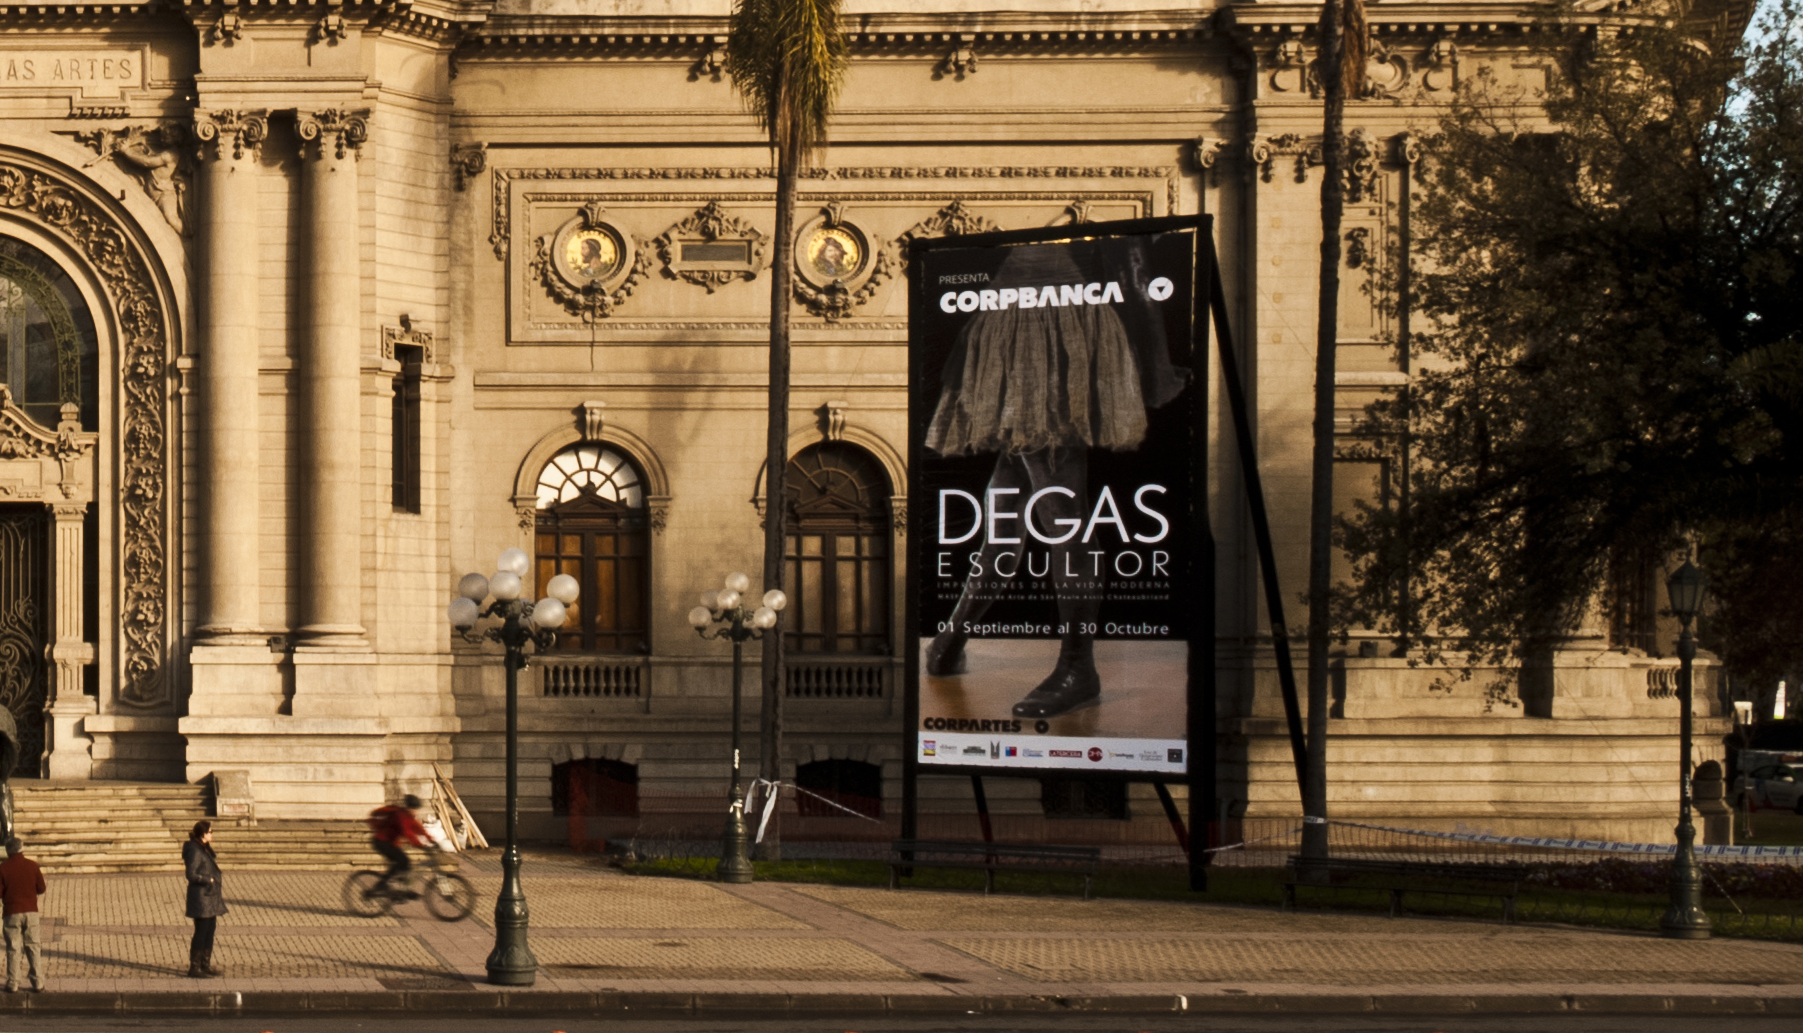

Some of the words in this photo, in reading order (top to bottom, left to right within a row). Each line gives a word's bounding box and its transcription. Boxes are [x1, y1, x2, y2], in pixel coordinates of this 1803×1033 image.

[52, 58, 133, 81] ARTES
[938, 272, 990, 285] PRESENTA
[939, 281, 1124, 314] CORPBANCA
[938, 484, 1169, 544] DEGAS
[938, 550, 1169, 577] ESCULTOR
[937, 581, 1024, 589] IMPRESIONES
[1032, 581, 1046, 589] DE
[1056, 581, 1068, 589] LA
[1076, 581, 1103, 589] VIDA
[1110, 581, 1170, 589] MODERNA
[937, 621, 954, 633] 01
[963, 621, 1051, 635] Septiembre
[1057, 621, 1070, 634] al
[1079, 622, 1096, 634] 30
[1105, 622, 1170, 634] Octubre
[923, 717, 1021, 733] CORPARTES
